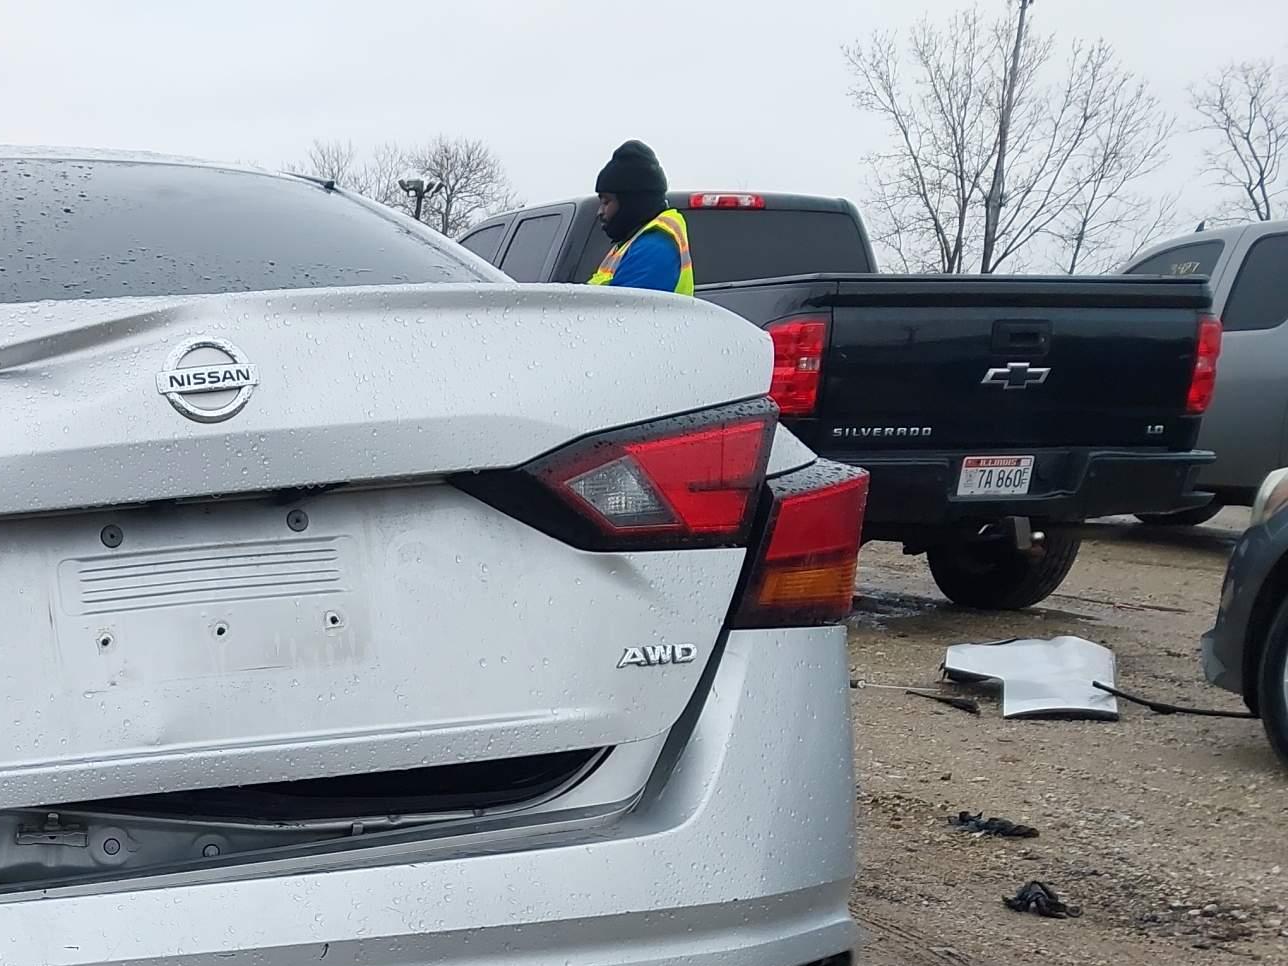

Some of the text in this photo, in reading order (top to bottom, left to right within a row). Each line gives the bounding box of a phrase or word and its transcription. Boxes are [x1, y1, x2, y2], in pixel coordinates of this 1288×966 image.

[169, 368, 250, 388] NISSAN
[832, 427, 932, 437] SILVERADO
[616, 643, 698, 668] AWD
